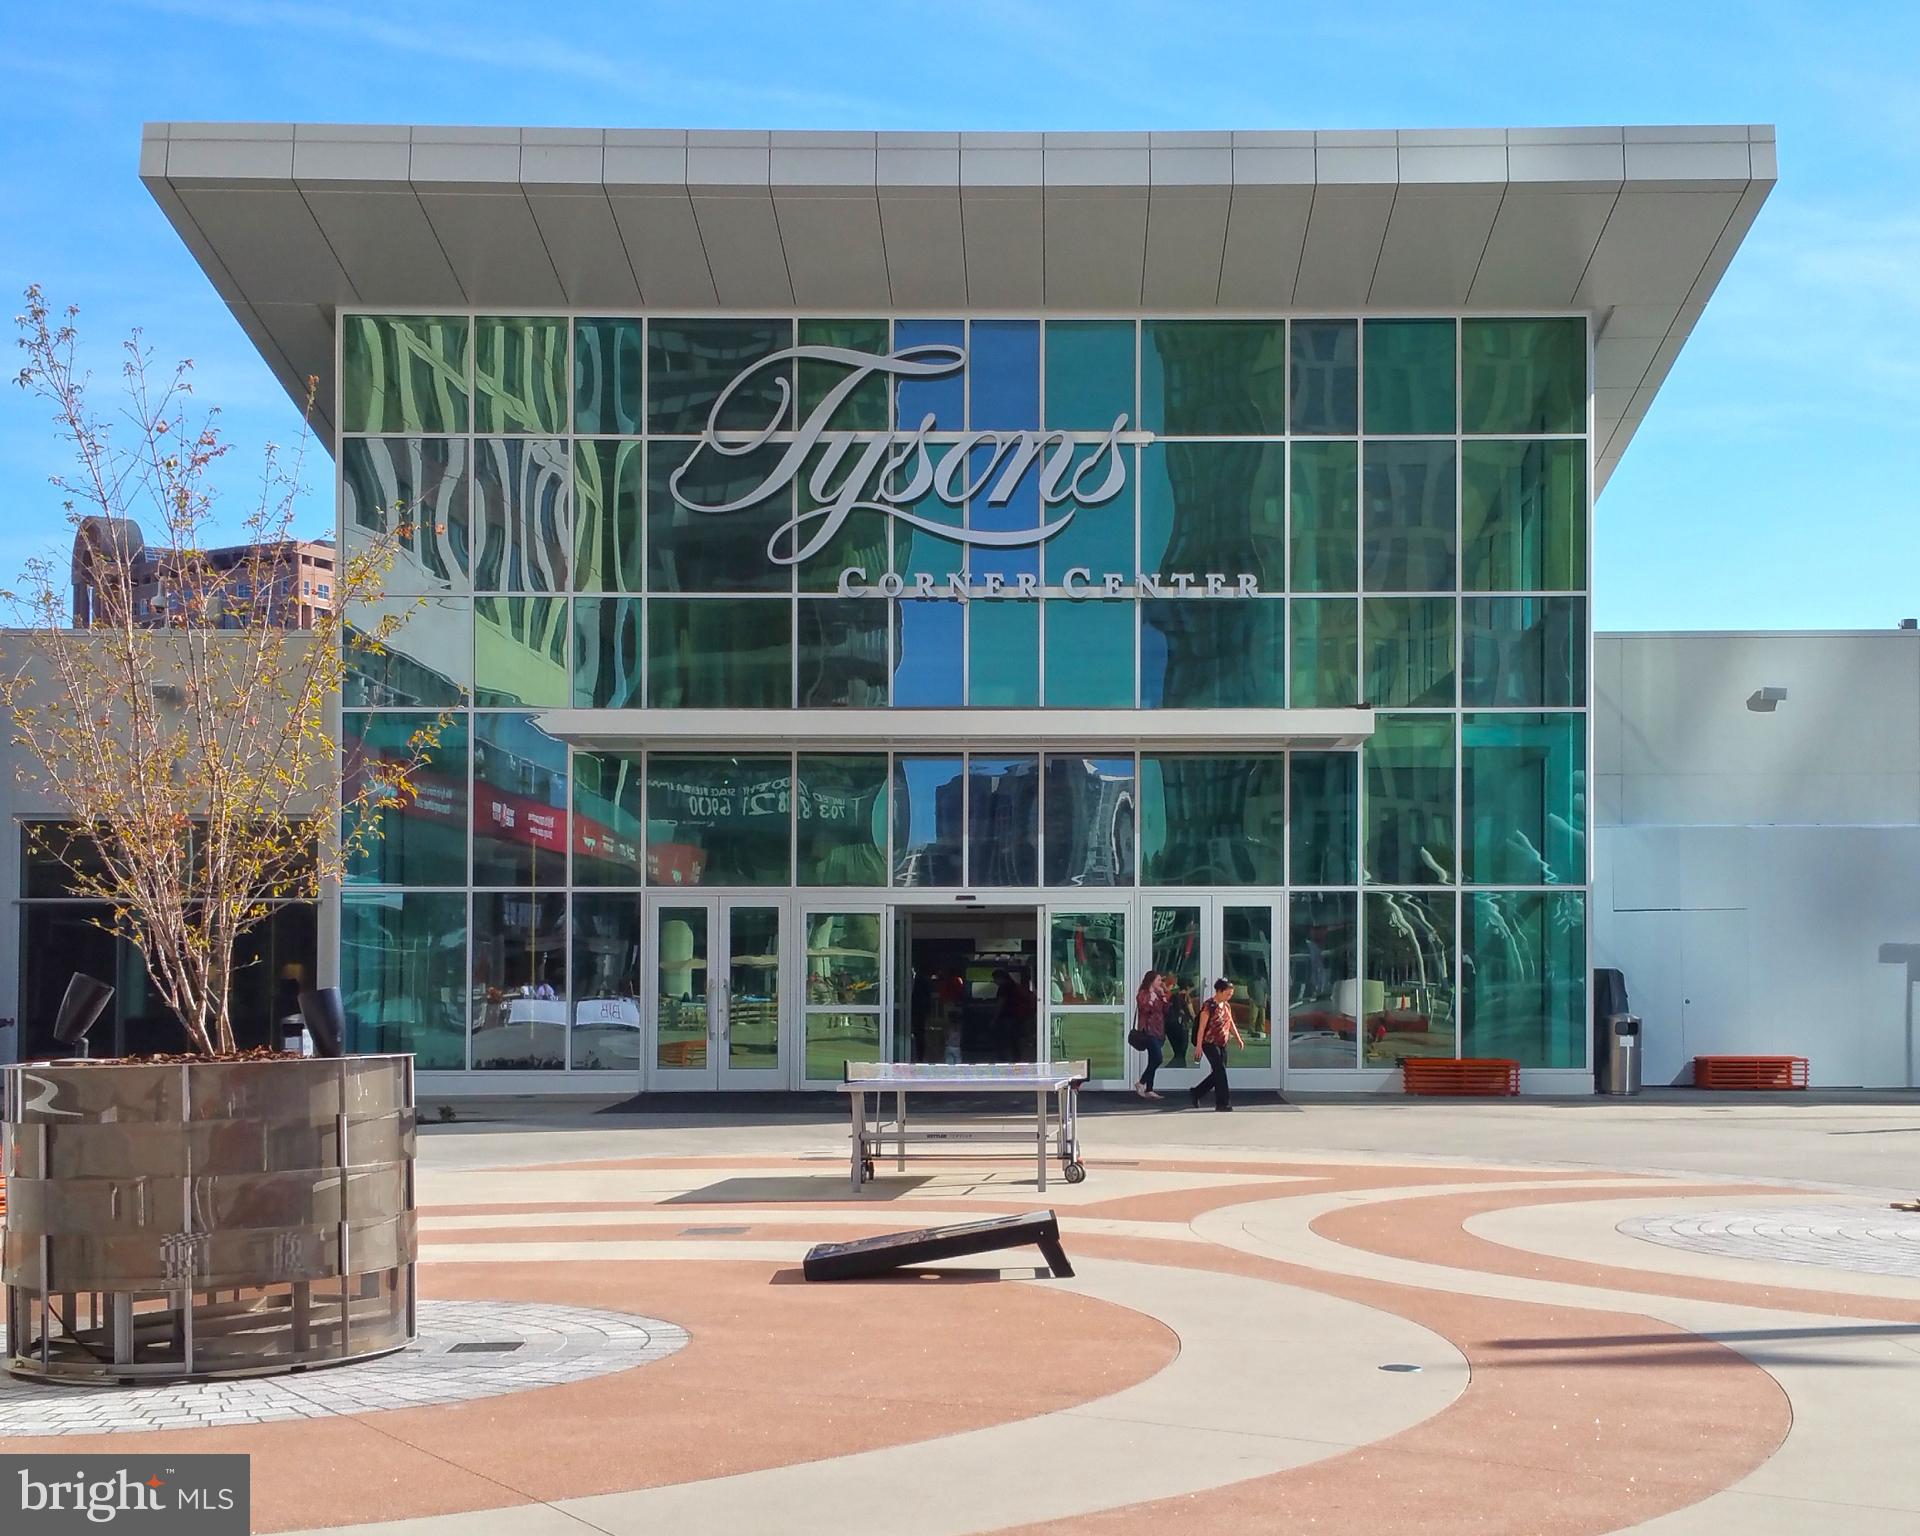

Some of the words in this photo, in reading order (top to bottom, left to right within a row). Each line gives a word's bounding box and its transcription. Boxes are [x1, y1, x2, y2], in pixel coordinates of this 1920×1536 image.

[670, 344, 1128, 566] Tysons
[838, 567, 1039, 599] CORNER
[1062, 567, 1260, 599] CENTER
